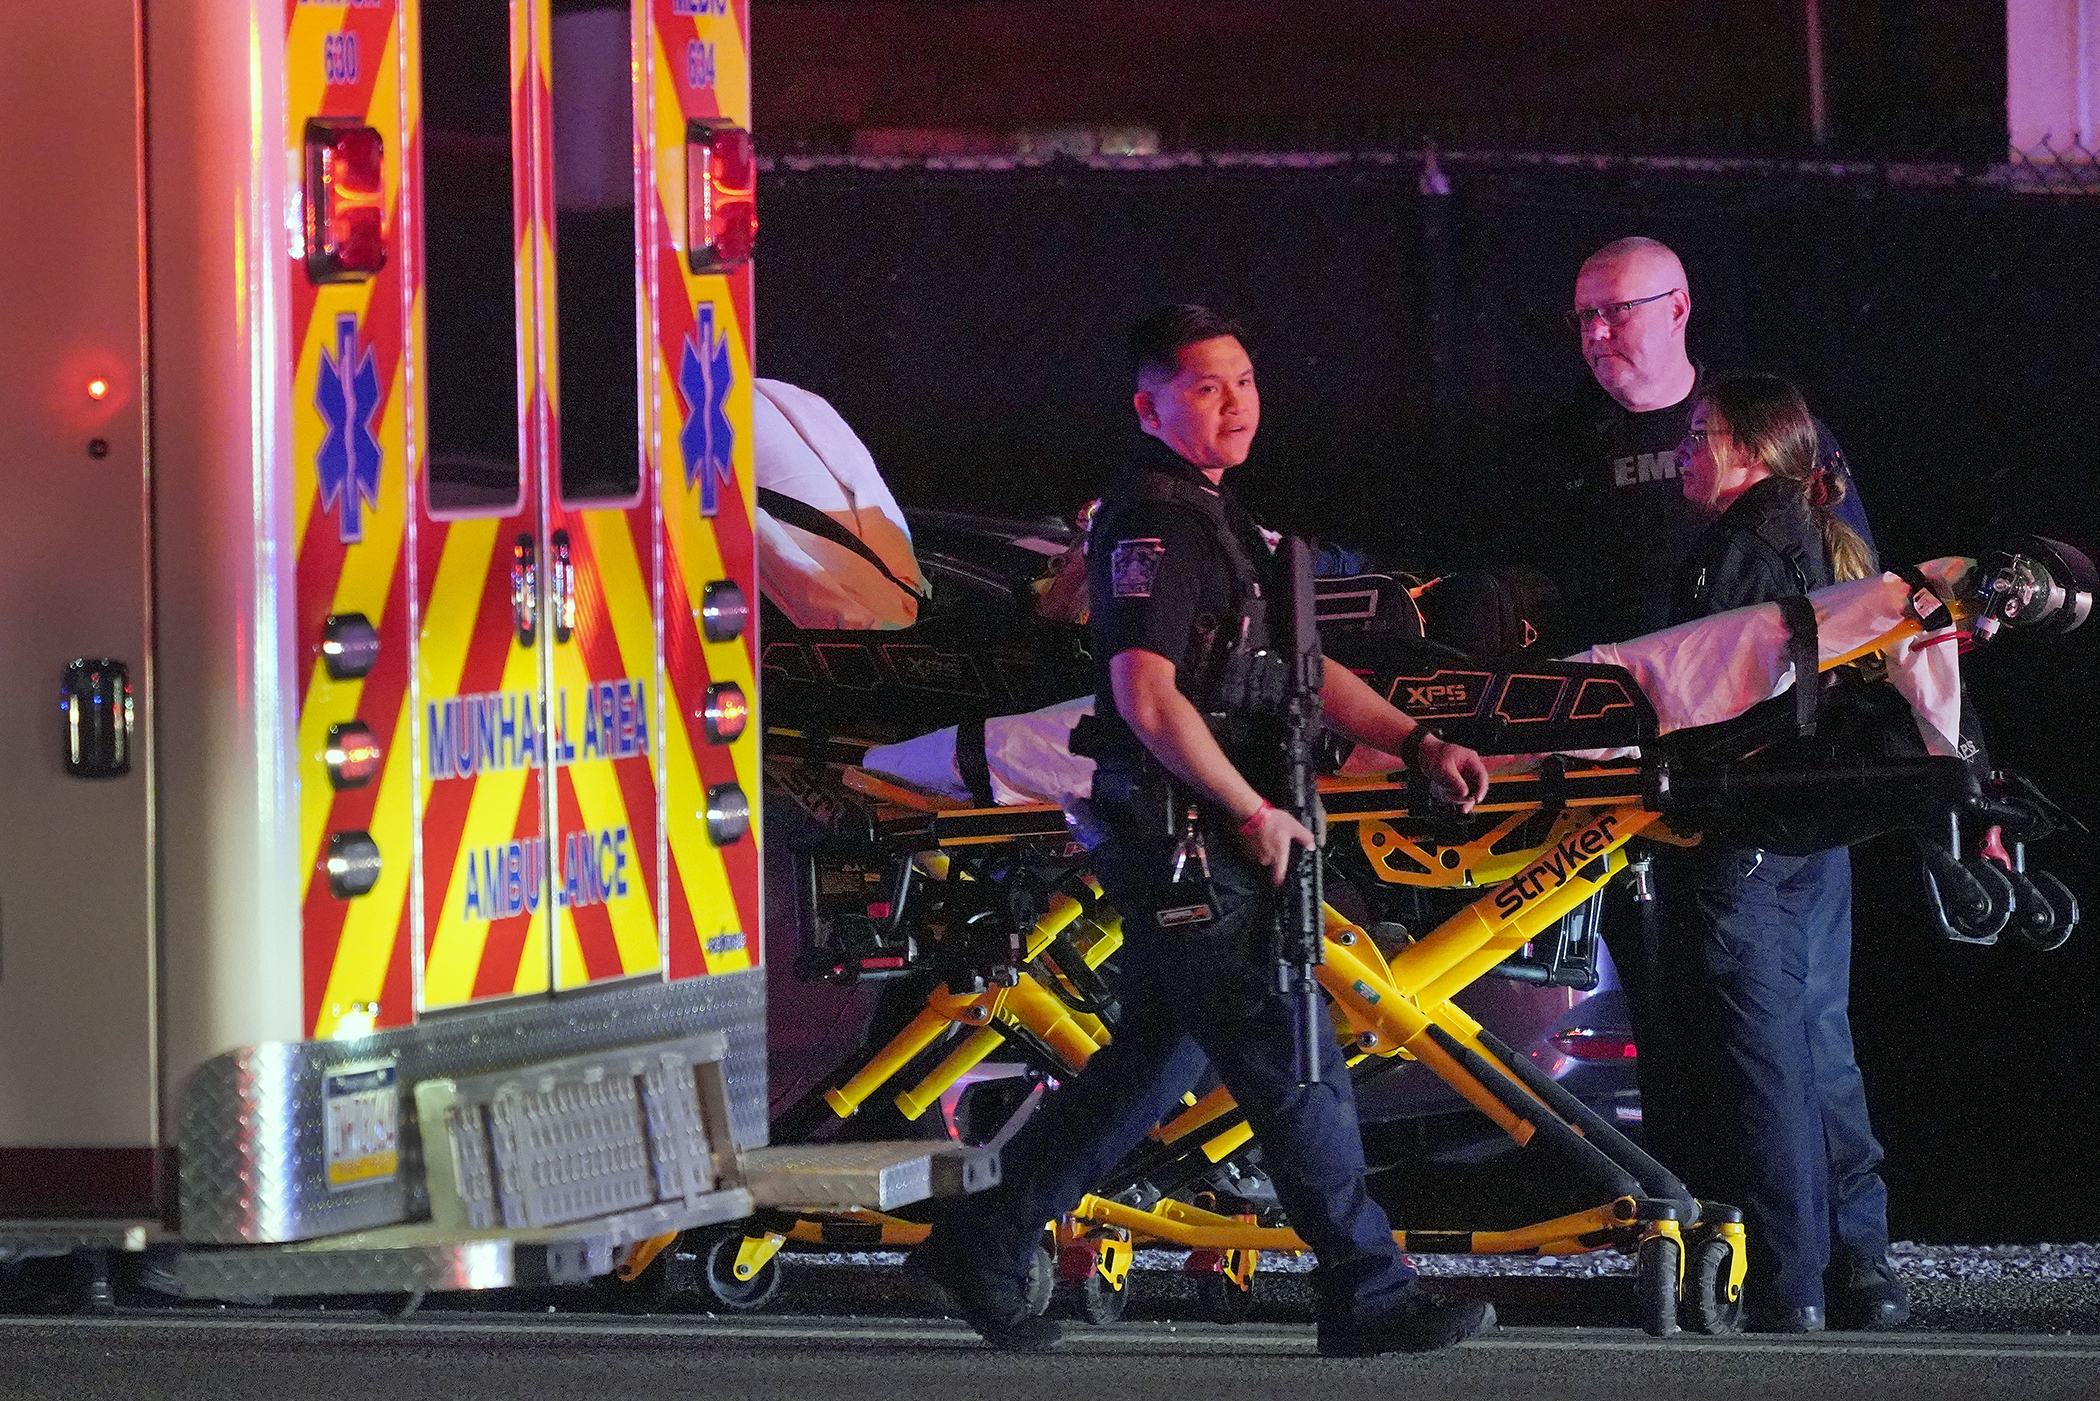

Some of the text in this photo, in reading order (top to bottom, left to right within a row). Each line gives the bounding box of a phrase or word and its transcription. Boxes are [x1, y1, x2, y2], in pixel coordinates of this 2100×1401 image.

[324, 34, 358, 81] 630
[1613, 450, 1683, 487] EM
[1407, 684, 1467, 707] XPS
[583, 680, 650, 760] AREA
[1495, 815, 1618, 920] stryker
